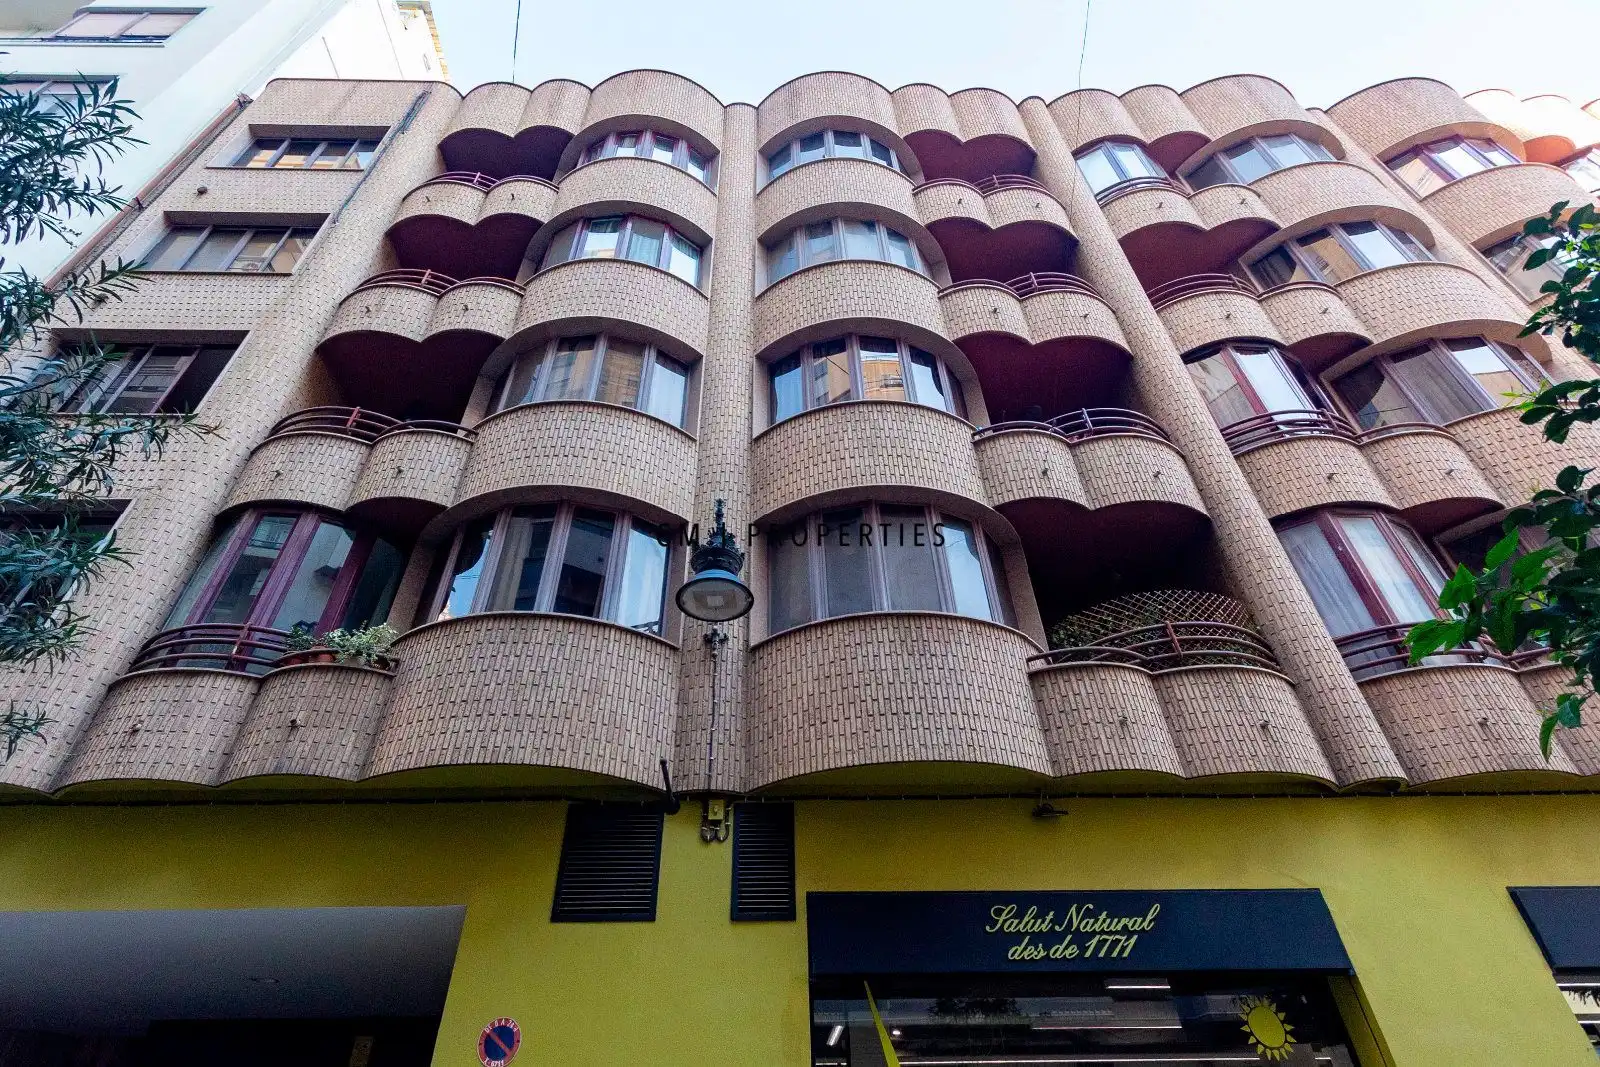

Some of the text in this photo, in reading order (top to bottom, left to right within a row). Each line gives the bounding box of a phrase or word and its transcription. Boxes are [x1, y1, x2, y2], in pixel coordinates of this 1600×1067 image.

[985, 903, 1161, 933] Salut Natural
[1007, 934, 1138, 960] des de 1771
